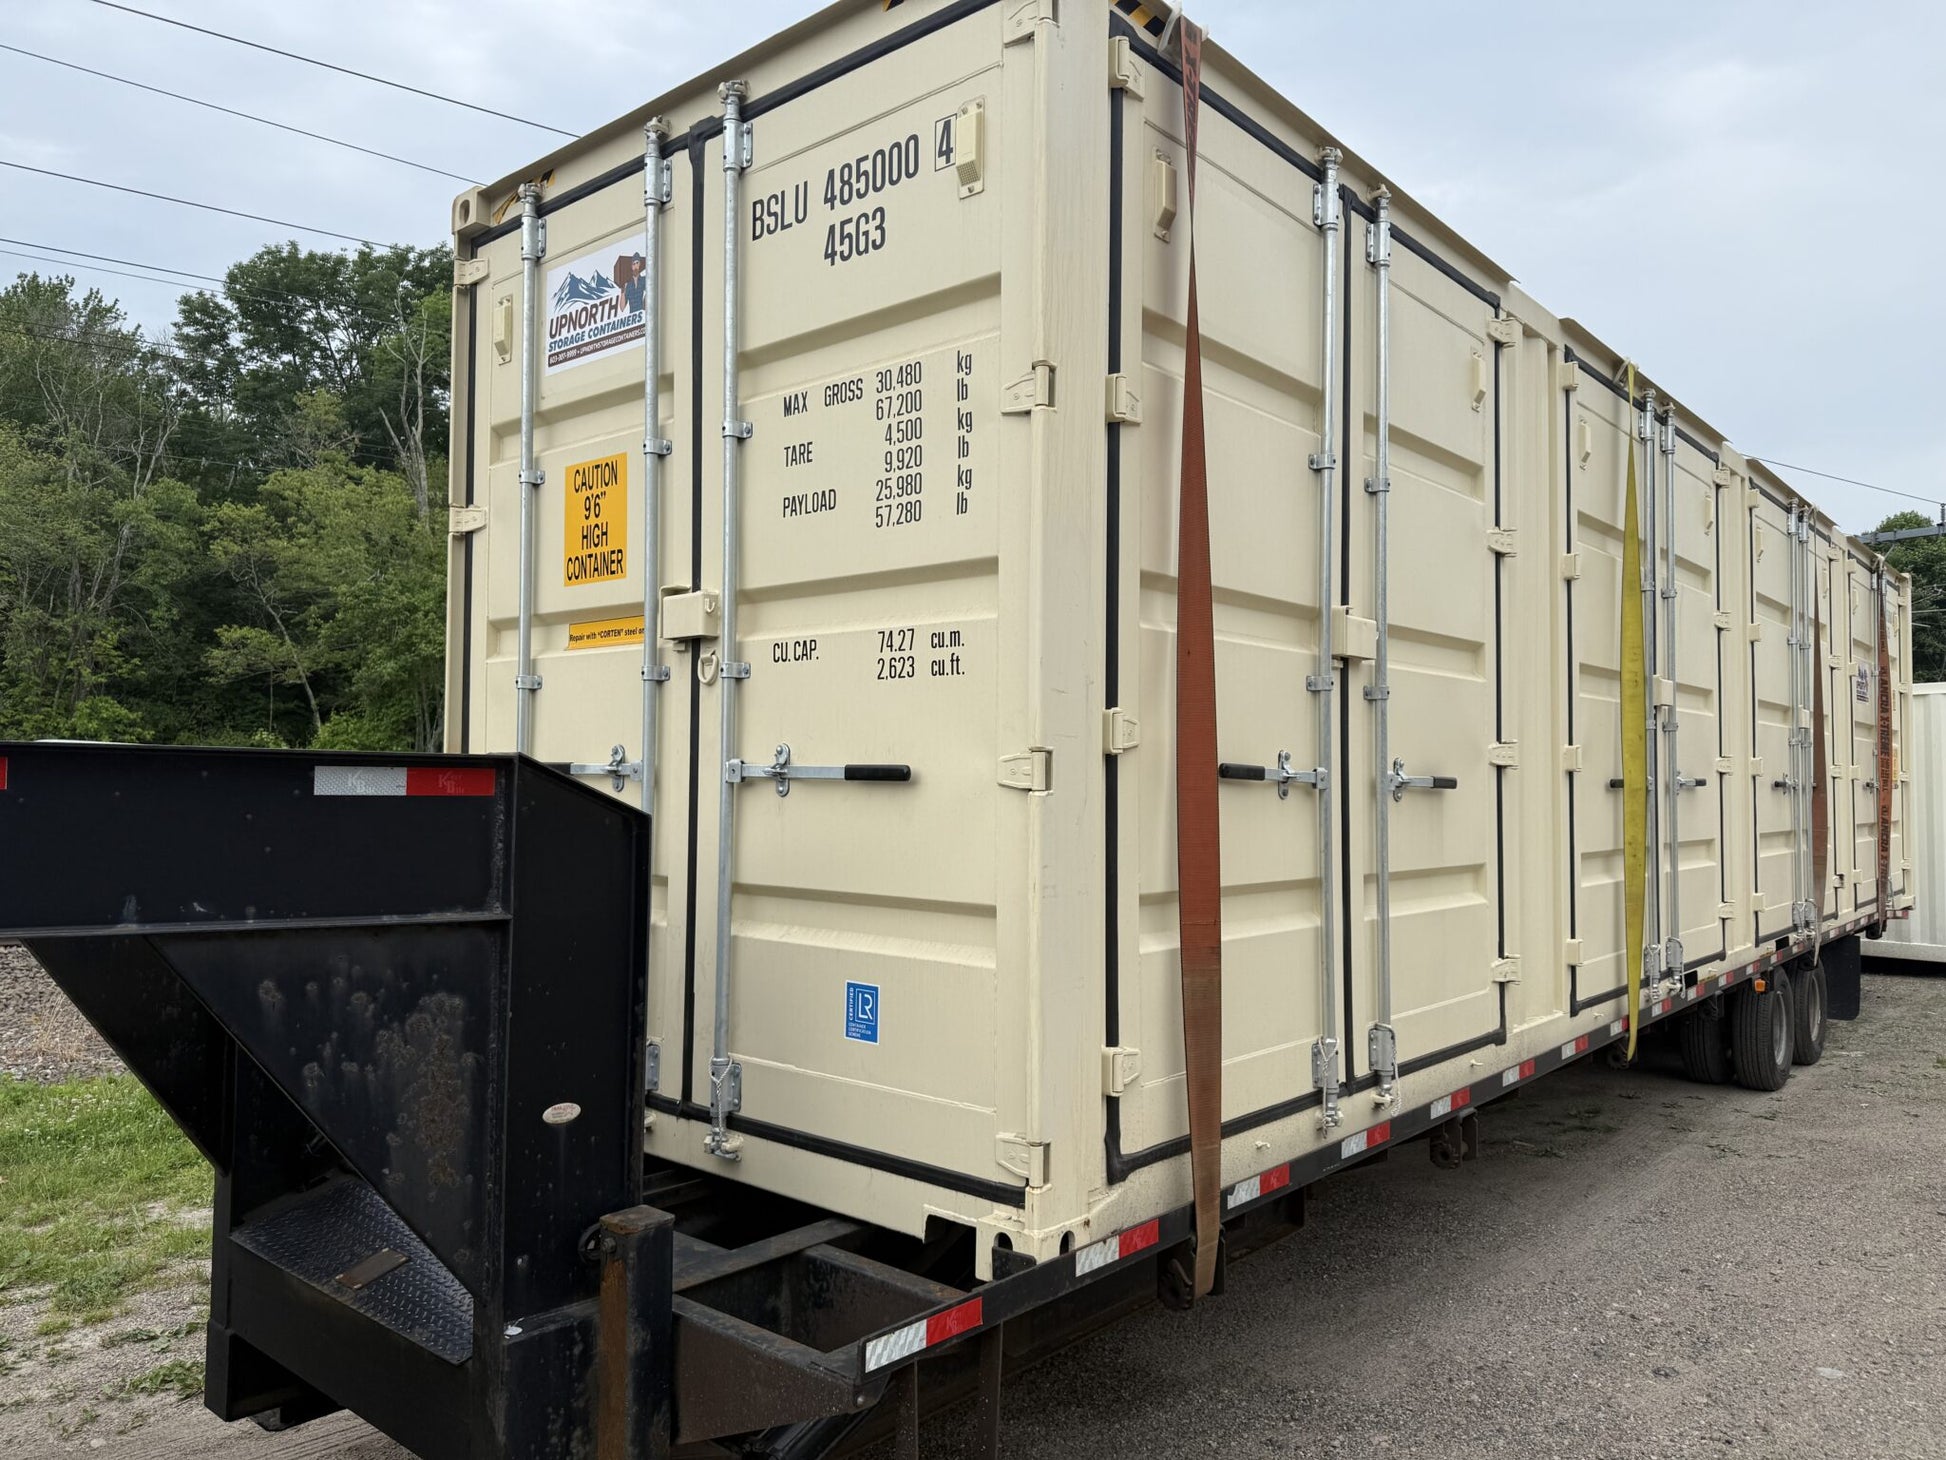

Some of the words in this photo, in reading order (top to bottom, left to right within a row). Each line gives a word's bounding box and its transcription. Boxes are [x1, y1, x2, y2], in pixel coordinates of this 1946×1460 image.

[752, 180, 808, 241] BSLU
[823, 133, 920, 211] 485000
[937, 119, 954, 164] 4
[823, 206, 886, 266] 45G3
[549, 295, 619, 339] UPNORTH
[549, 331, 586, 352] STORAGE
[588, 311, 643, 338] CONTAINERS
[783, 391, 808, 417] MAX
[824, 378, 863, 407] GROSS
[876, 361, 922, 394] 30,480
[957, 350, 972, 375] kg
[876, 389, 922, 421] 67,200
[957, 378, 968, 402] lb
[784, 441, 813, 467] TARE
[885, 417, 922, 446] 4,500
[957, 407, 973, 433] kg
[885, 444, 922, 473] 9,920
[957, 435, 969, 459] lb
[574, 460, 618, 494] CAUTION
[783, 488, 836, 518] PAYLOAD
[876, 472, 922, 502] 25,980
[957, 464, 972, 490] kg
[875, 500, 922, 528] 57,280
[956, 492, 968, 515] lb
[581, 521, 608, 550] HIGH
[566, 548, 624, 582] CONTAINER
[569, 632, 585, 643] Repair
[586, 631, 597, 640] with
[624, 626, 638, 636] steel
[877, 628, 915, 653] 74.27
[877, 655, 915, 680] 2,623
[1880, 678, 1889, 714] ANCRA
